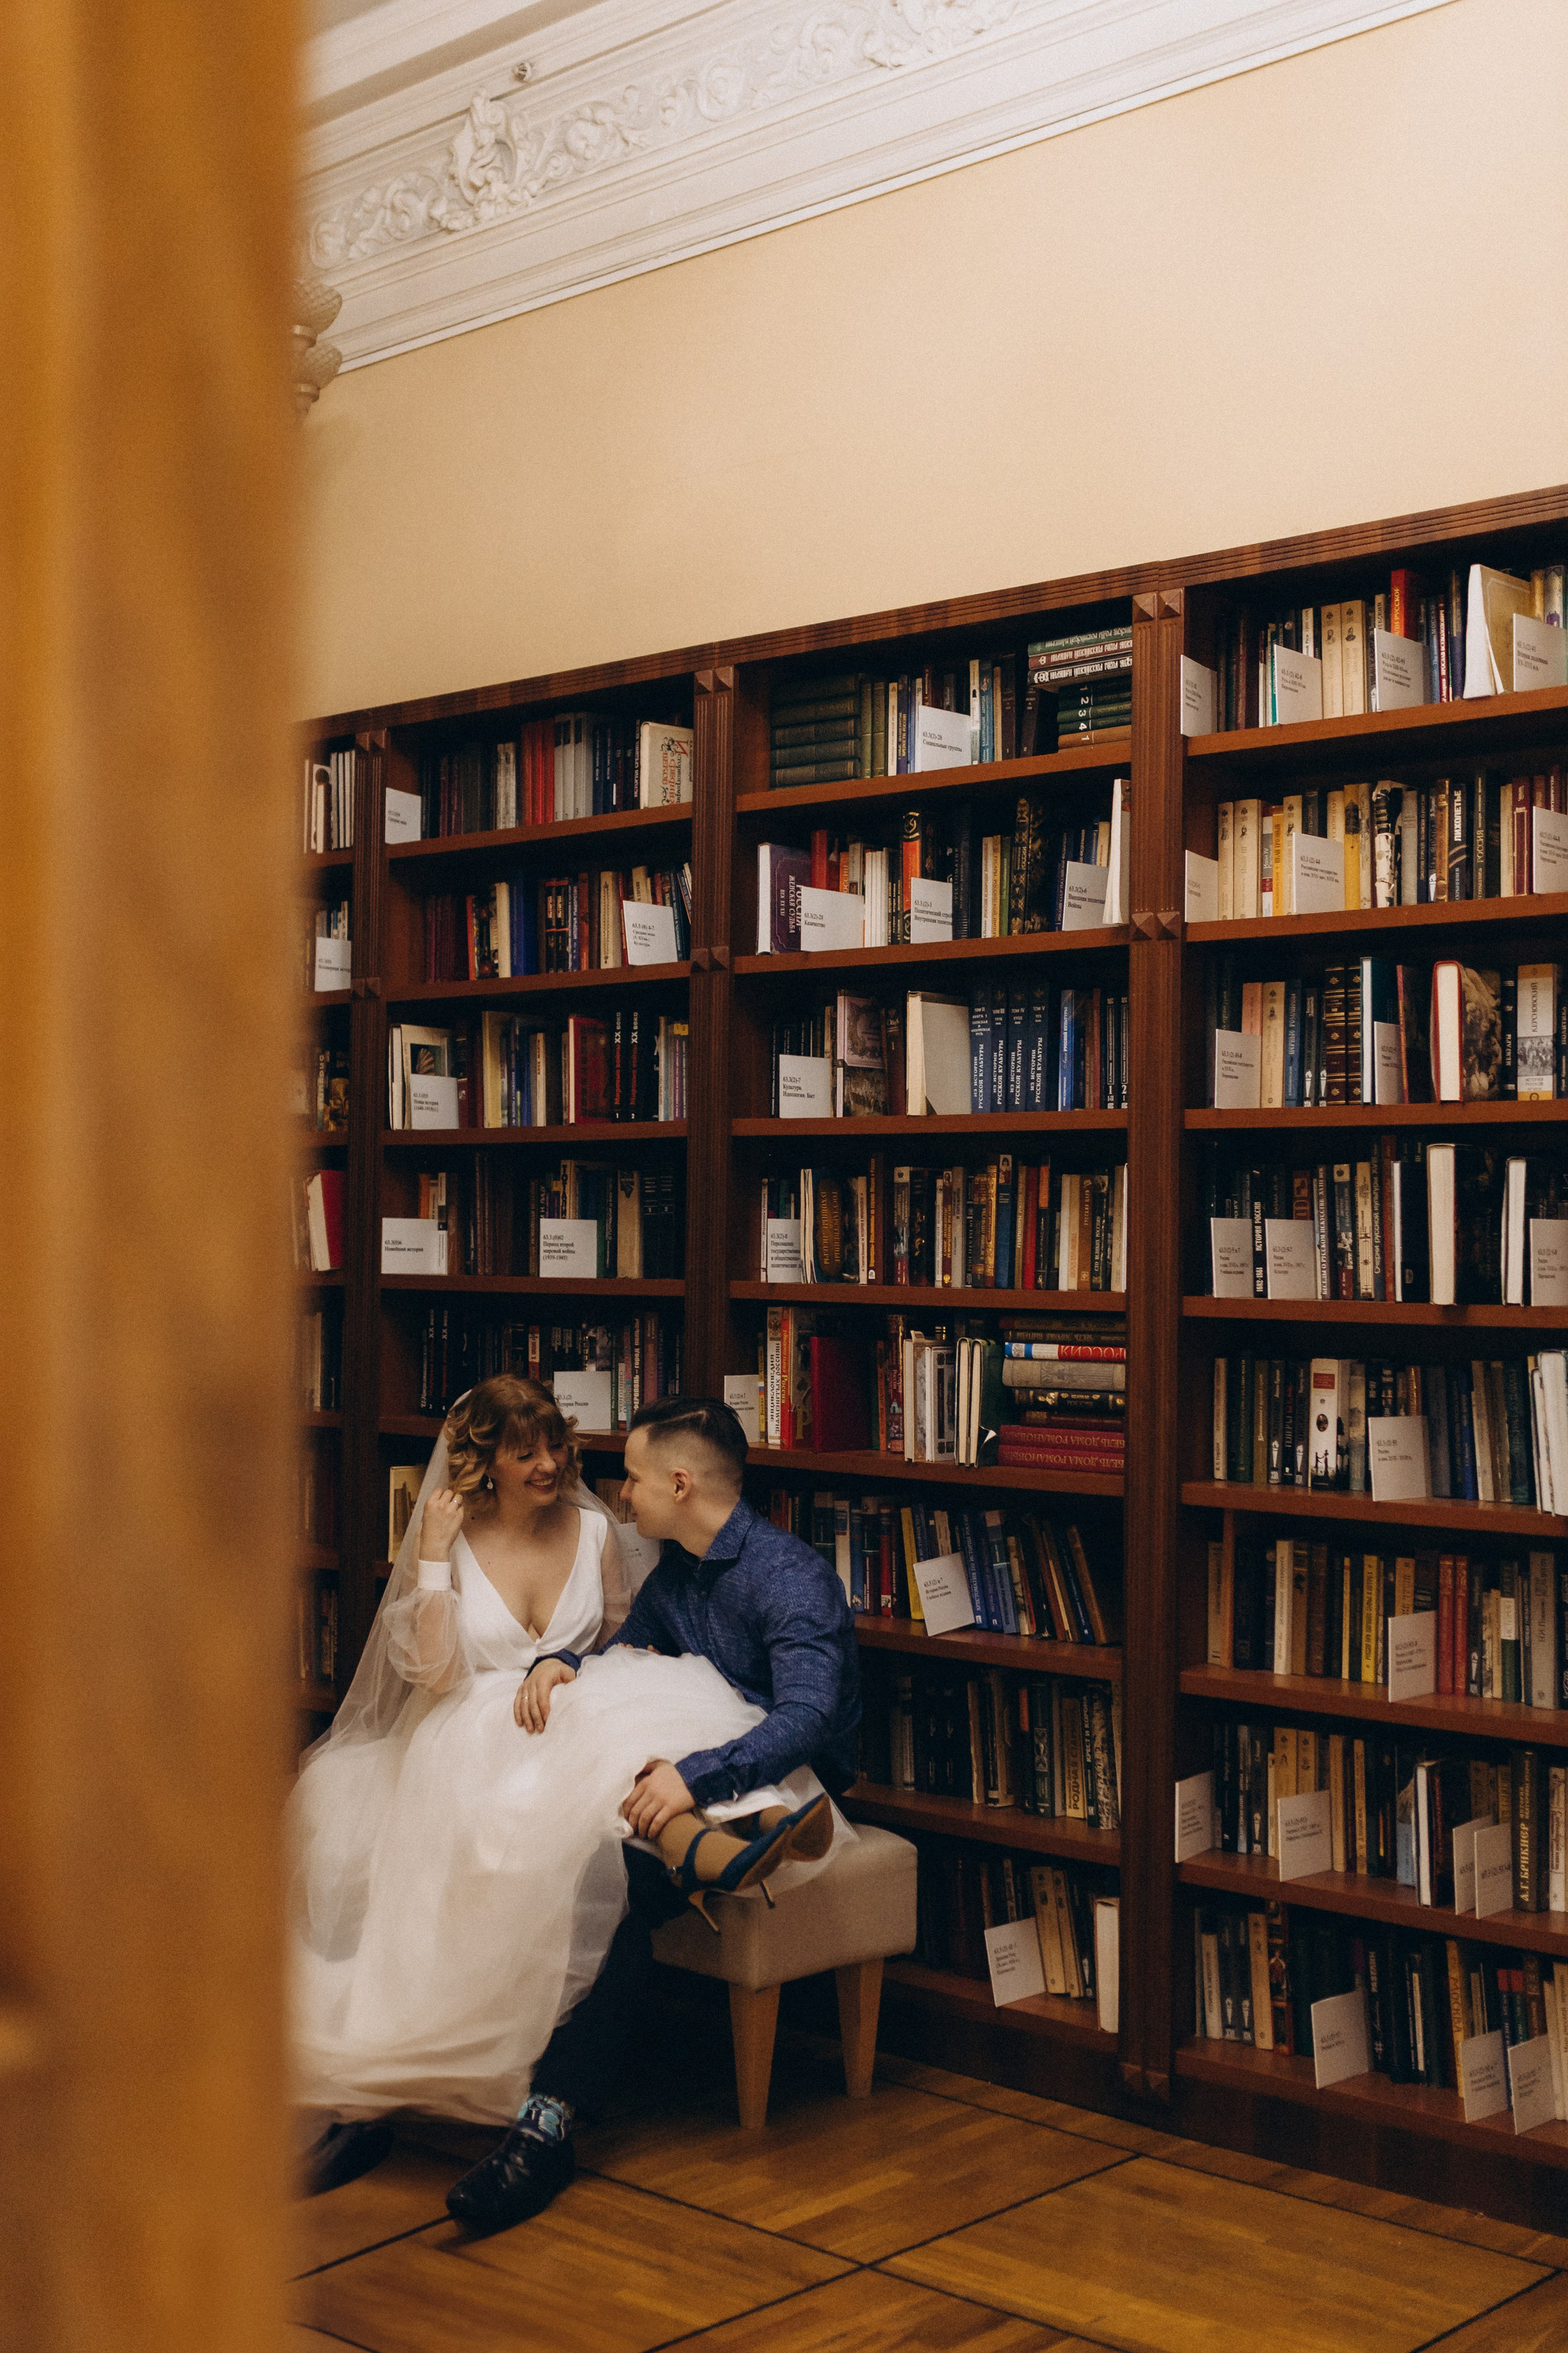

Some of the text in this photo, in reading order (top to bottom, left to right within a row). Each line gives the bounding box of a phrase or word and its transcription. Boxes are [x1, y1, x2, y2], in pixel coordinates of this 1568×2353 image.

[1453, 790, 1462, 842] ЛИХОЛЕТЬЕ
[1530, 982, 1539, 1033] КЕРСНОВСКИЙ
[614, 1031, 621, 1044] XX
[631, 1031, 638, 1044] XX
[993, 1084, 997, 1093] ИЗ
[1010, 1084, 1014, 1093] ИЗ
[1030, 1082, 1035, 1091] ИЗ
[1109, 1085, 1113, 1095] 1
[1121, 1084, 1127, 1094] 2
[973, 1089, 978, 1097] ИЗ
[1061, 1345, 1123, 1359] РОССИЯ
[1070, 1435, 1100, 1447] ДОМА
[1069, 1455, 1099, 1467] ДОМА
[1070, 1761, 1080, 1811] РОДНАЯ
